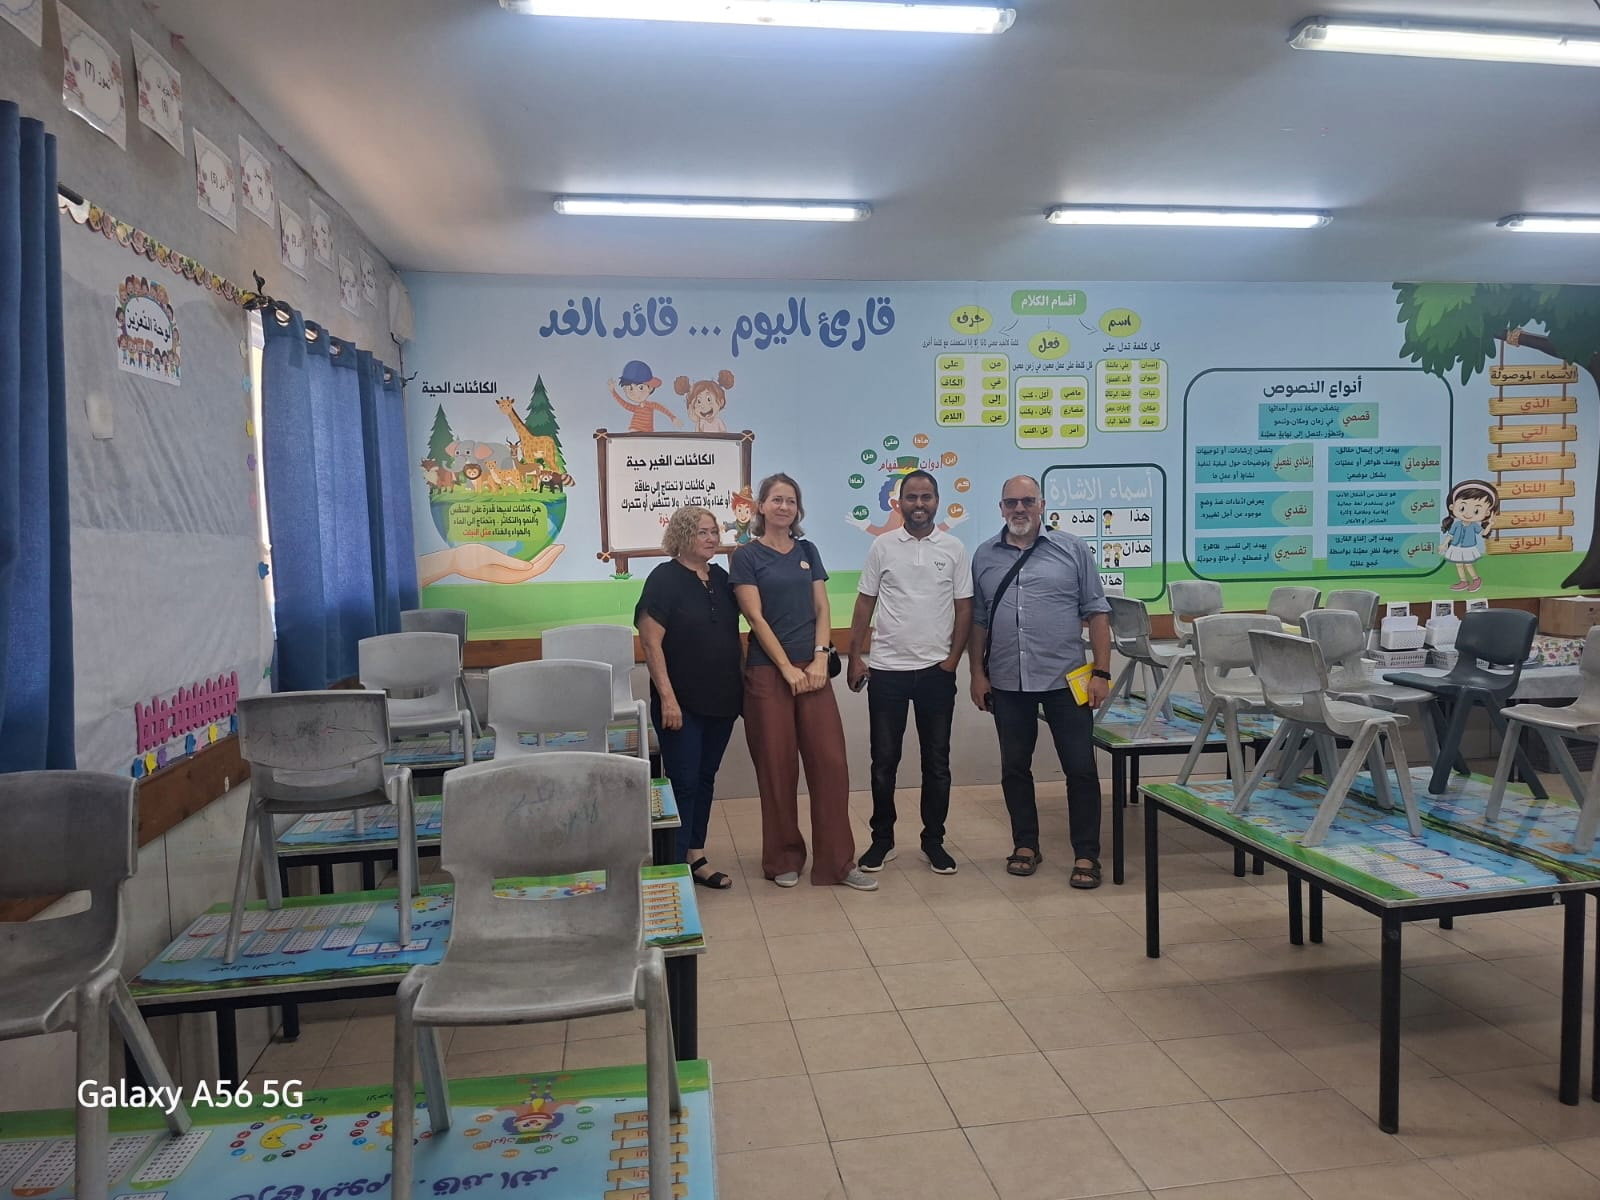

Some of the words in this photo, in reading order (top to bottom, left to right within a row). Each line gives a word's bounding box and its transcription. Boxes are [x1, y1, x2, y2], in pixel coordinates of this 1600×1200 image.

[1021, 295, 1049, 309] الكلام
[1051, 294, 1076, 310] أقسام
[127, 308, 153, 331] التعزيز
[539, 296, 607, 338] الغد
[613, 296, 678, 338] قائد
[818, 296, 895, 351] قارئ
[956, 312, 984, 327] حرف
[1108, 316, 1132, 331] اسم
[153, 319, 170, 342] لوحة
[731, 296, 811, 357] اليوم
[1038, 337, 1060, 353] فعل
[1103, 342, 1115, 352] على
[1118, 342, 1131, 352] تدل
[1133, 342, 1147, 351] كلمة
[1150, 342, 1160, 352] كل
[944, 360, 959, 369] على
[1491, 370, 1535, 381] الموصولة
[422, 381, 450, 397] الحية
[453, 380, 497, 394] الكائنات
[991, 379, 1001, 389] في
[1264, 380, 1324, 397] النصوص
[1329, 375, 1361, 398] أنواع
[944, 396, 959, 404] الباء
[988, 395, 1000, 404] إلى
[1039, 389, 1048, 399] أكل
[1521, 398, 1549, 413] الذي
[943, 413, 962, 422] اللام
[990, 414, 1002, 422] عن
[1069, 424, 1079, 434] أمر
[1522, 426, 1547, 441] التي
[884, 438, 898, 447] متى
[674, 453, 714, 466] الكائنات
[863, 451, 873, 459] من
[627, 456, 646, 470] حية
[649, 455, 672, 470] الغير
[920, 454, 943, 471] أدوات
[1405, 457, 1440, 472] معلوماتي
[635, 480, 651, 492] طاقة
[685, 479, 704, 490] كائنات
[1110, 470, 1152, 501] أسماء
[1071, 511, 1095, 523] هذه
[1130, 509, 1150, 522] هذا
[1284, 505, 1307, 520] نقدي
[1511, 512, 1545, 525] الذين
[1122, 541, 1151, 556] هذان
[1275, 546, 1306, 561] تفسيري
[1407, 542, 1434, 558] إقناعي
[1101, 575, 1122, 586] هؤلا
[432, 1173, 494, 1197] قائد
[500, 1166, 559, 1190] الغد
